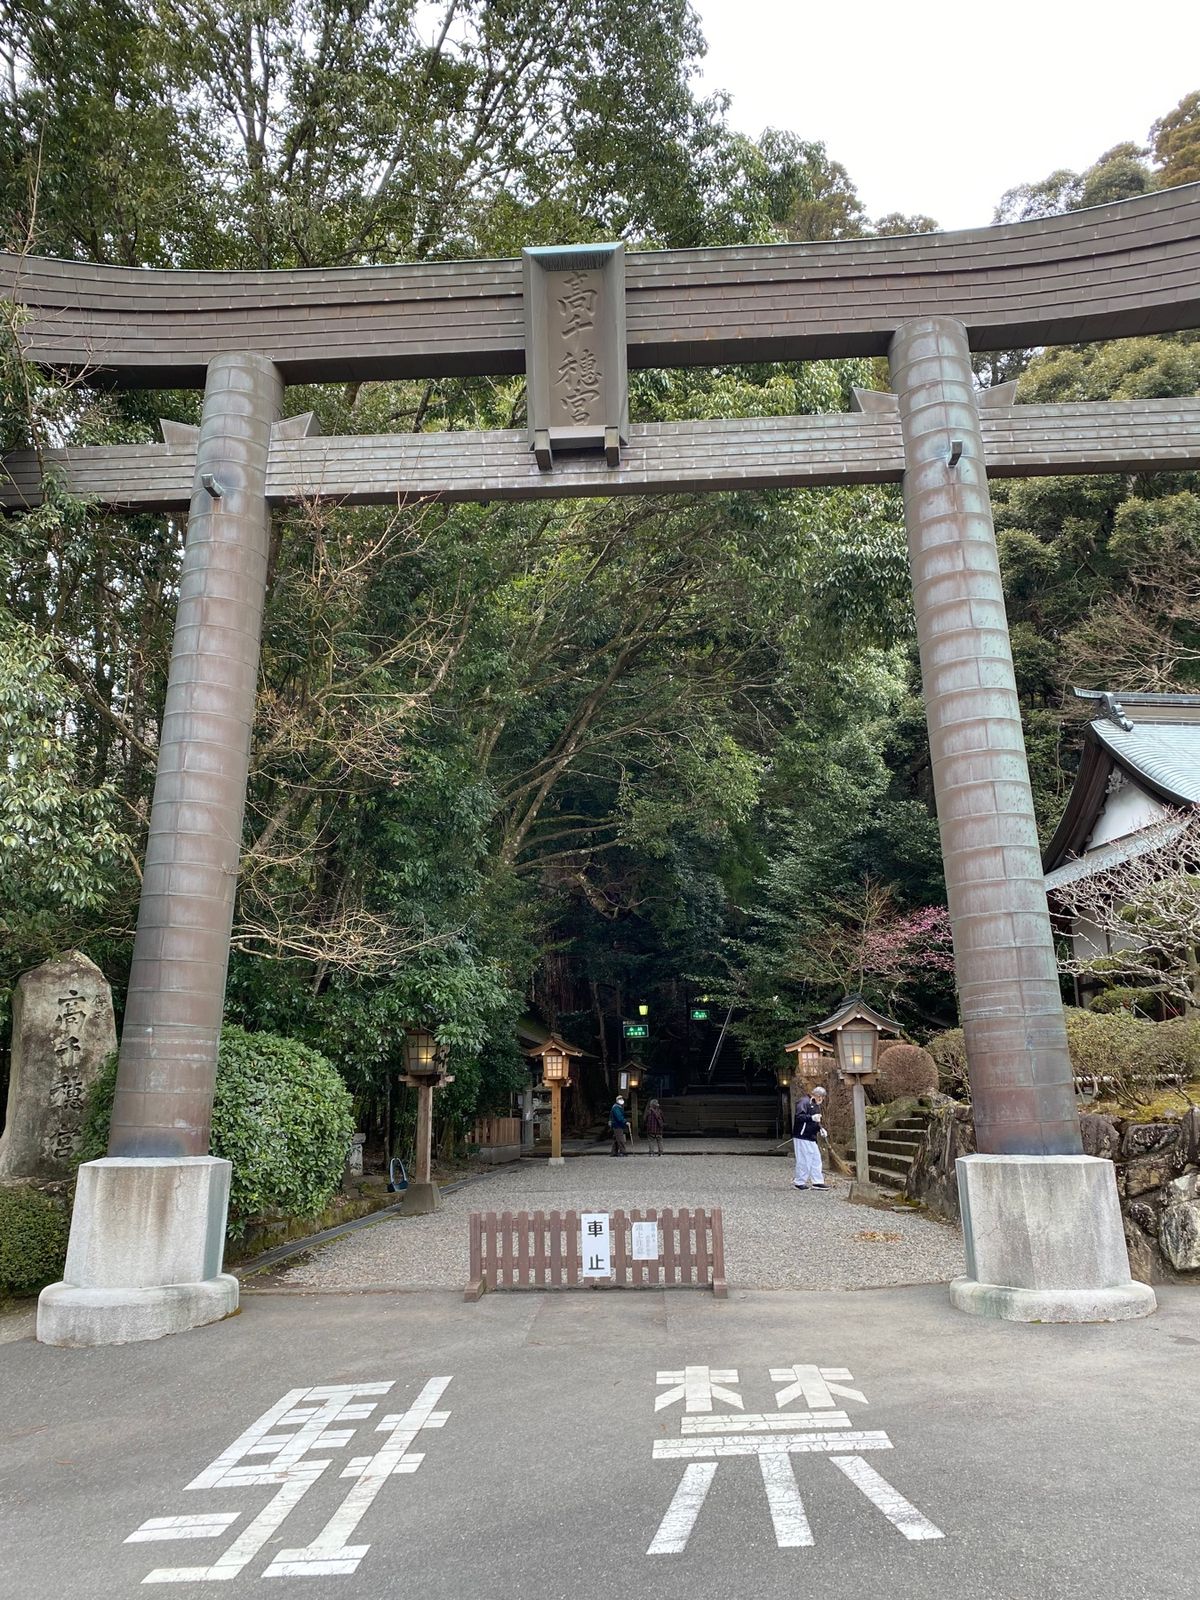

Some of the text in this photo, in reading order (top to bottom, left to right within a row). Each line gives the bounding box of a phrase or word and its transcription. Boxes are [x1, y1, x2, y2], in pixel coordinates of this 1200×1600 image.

[555, 271, 603, 426] 高千穂宮
[587, 1220, 605, 1271] 車止
